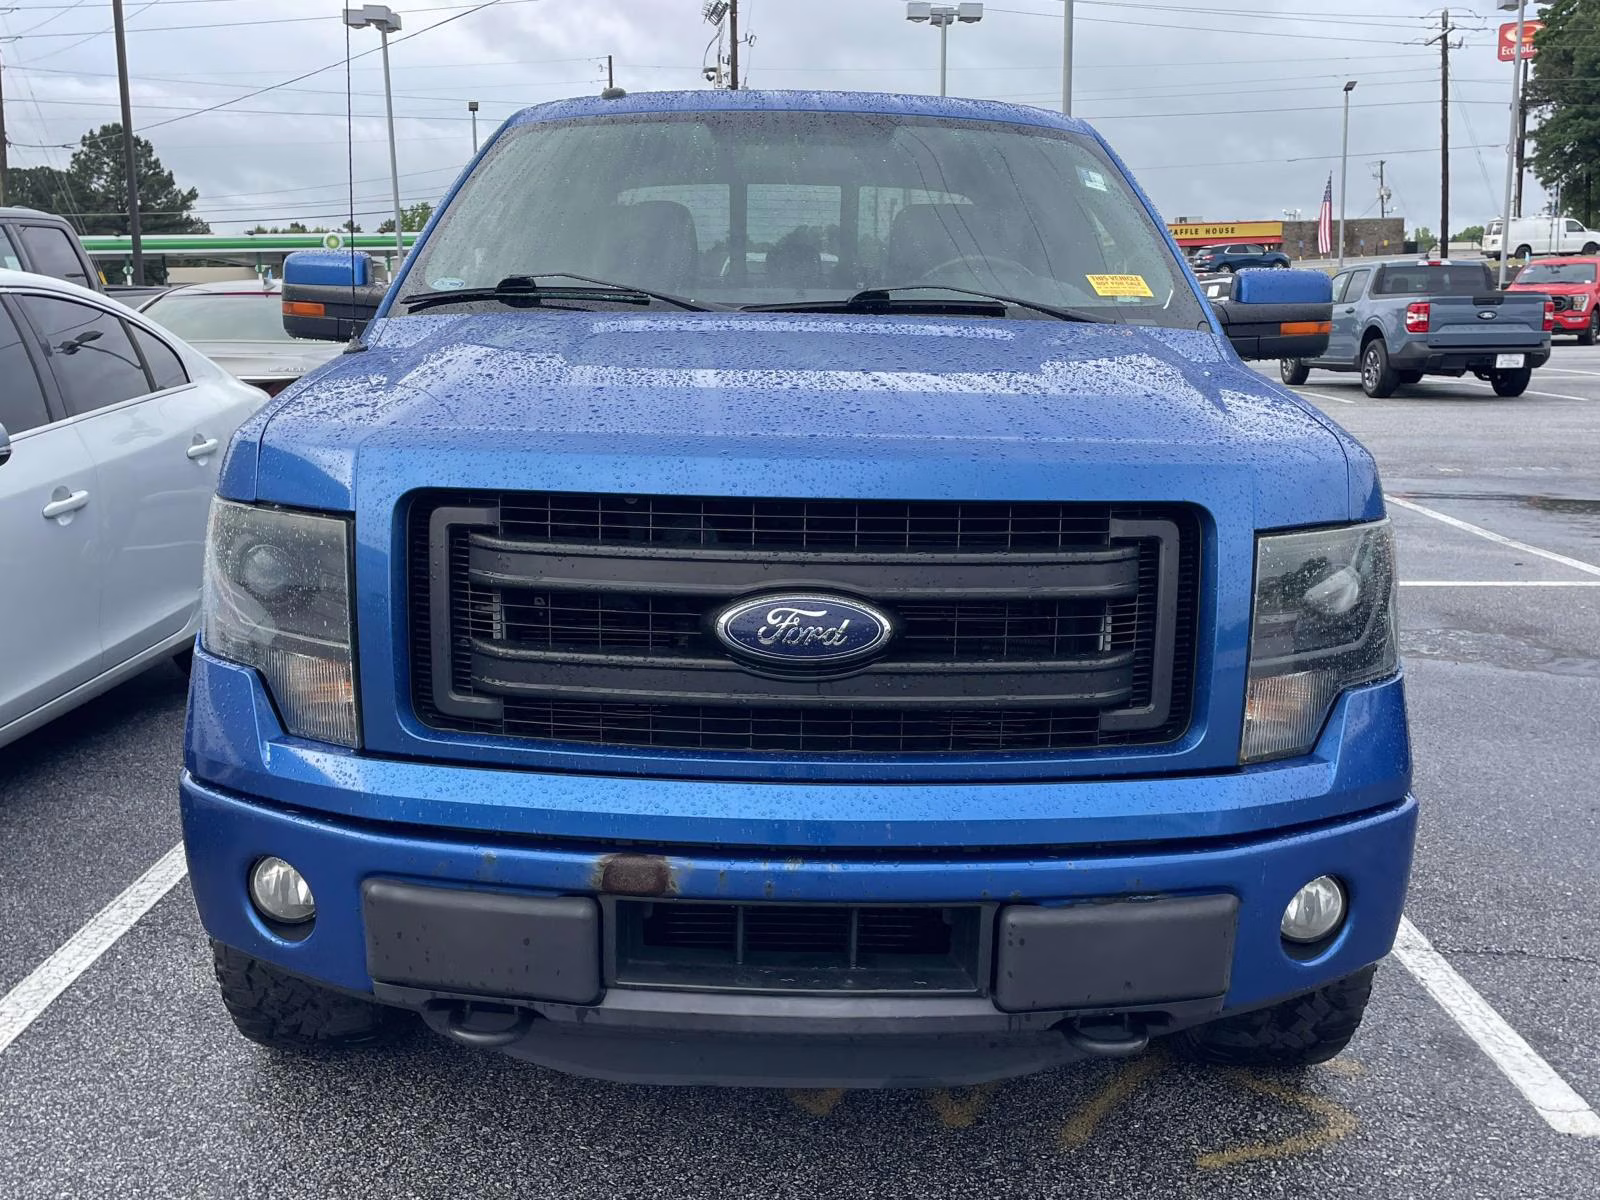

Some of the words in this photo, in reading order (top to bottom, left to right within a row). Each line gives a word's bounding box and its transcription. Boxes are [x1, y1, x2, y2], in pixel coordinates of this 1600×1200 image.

[1501, 45, 1526, 56] Ecoo
[1205, 226, 1235, 235] HOUSE
[757, 607, 850, 646] Ford
